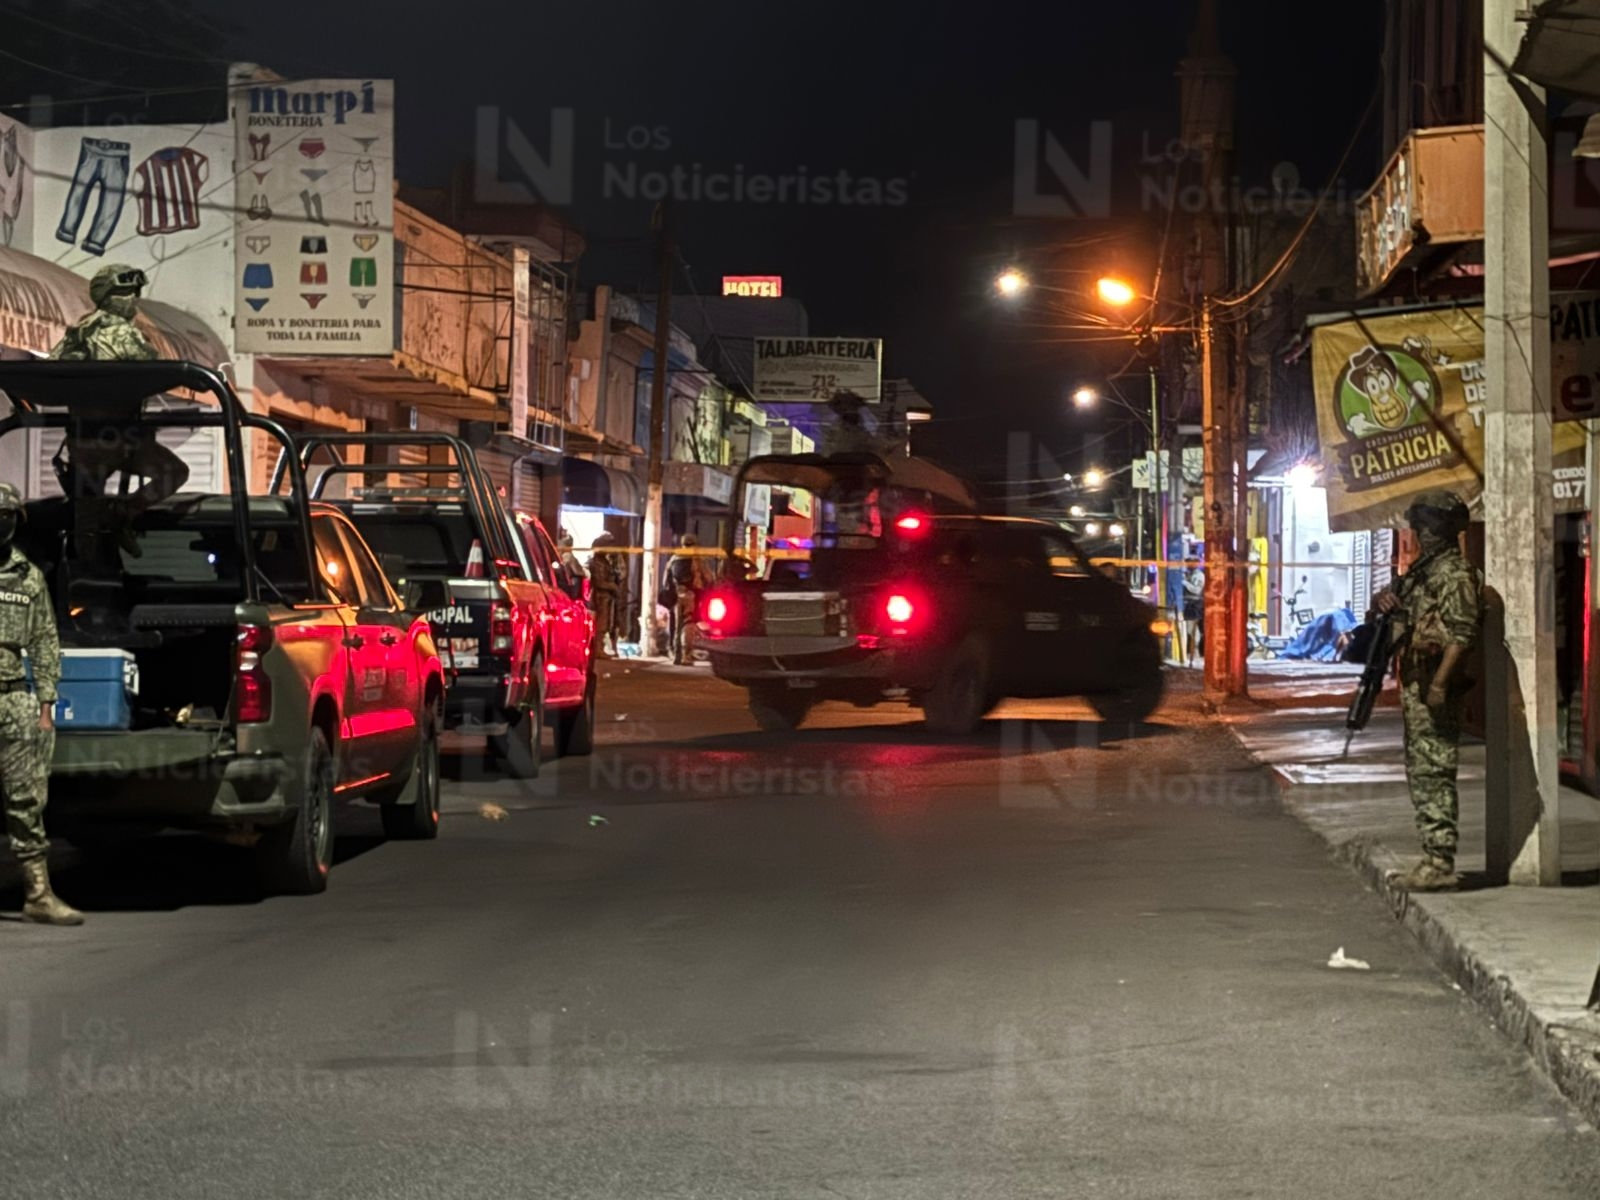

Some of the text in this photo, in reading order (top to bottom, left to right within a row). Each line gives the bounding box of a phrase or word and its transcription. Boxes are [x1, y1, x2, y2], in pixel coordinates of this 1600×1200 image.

[249, 81, 375, 125] marpí
[248, 115, 323, 127] BONETERIA
[247, 318, 381, 329] ROPA Y BONETERIA PARA
[266, 331, 361, 342] TODA LA FAMILIA
[758, 339, 876, 359] TALABARTERIA
[1350, 430, 1451, 479] PATRICIA
